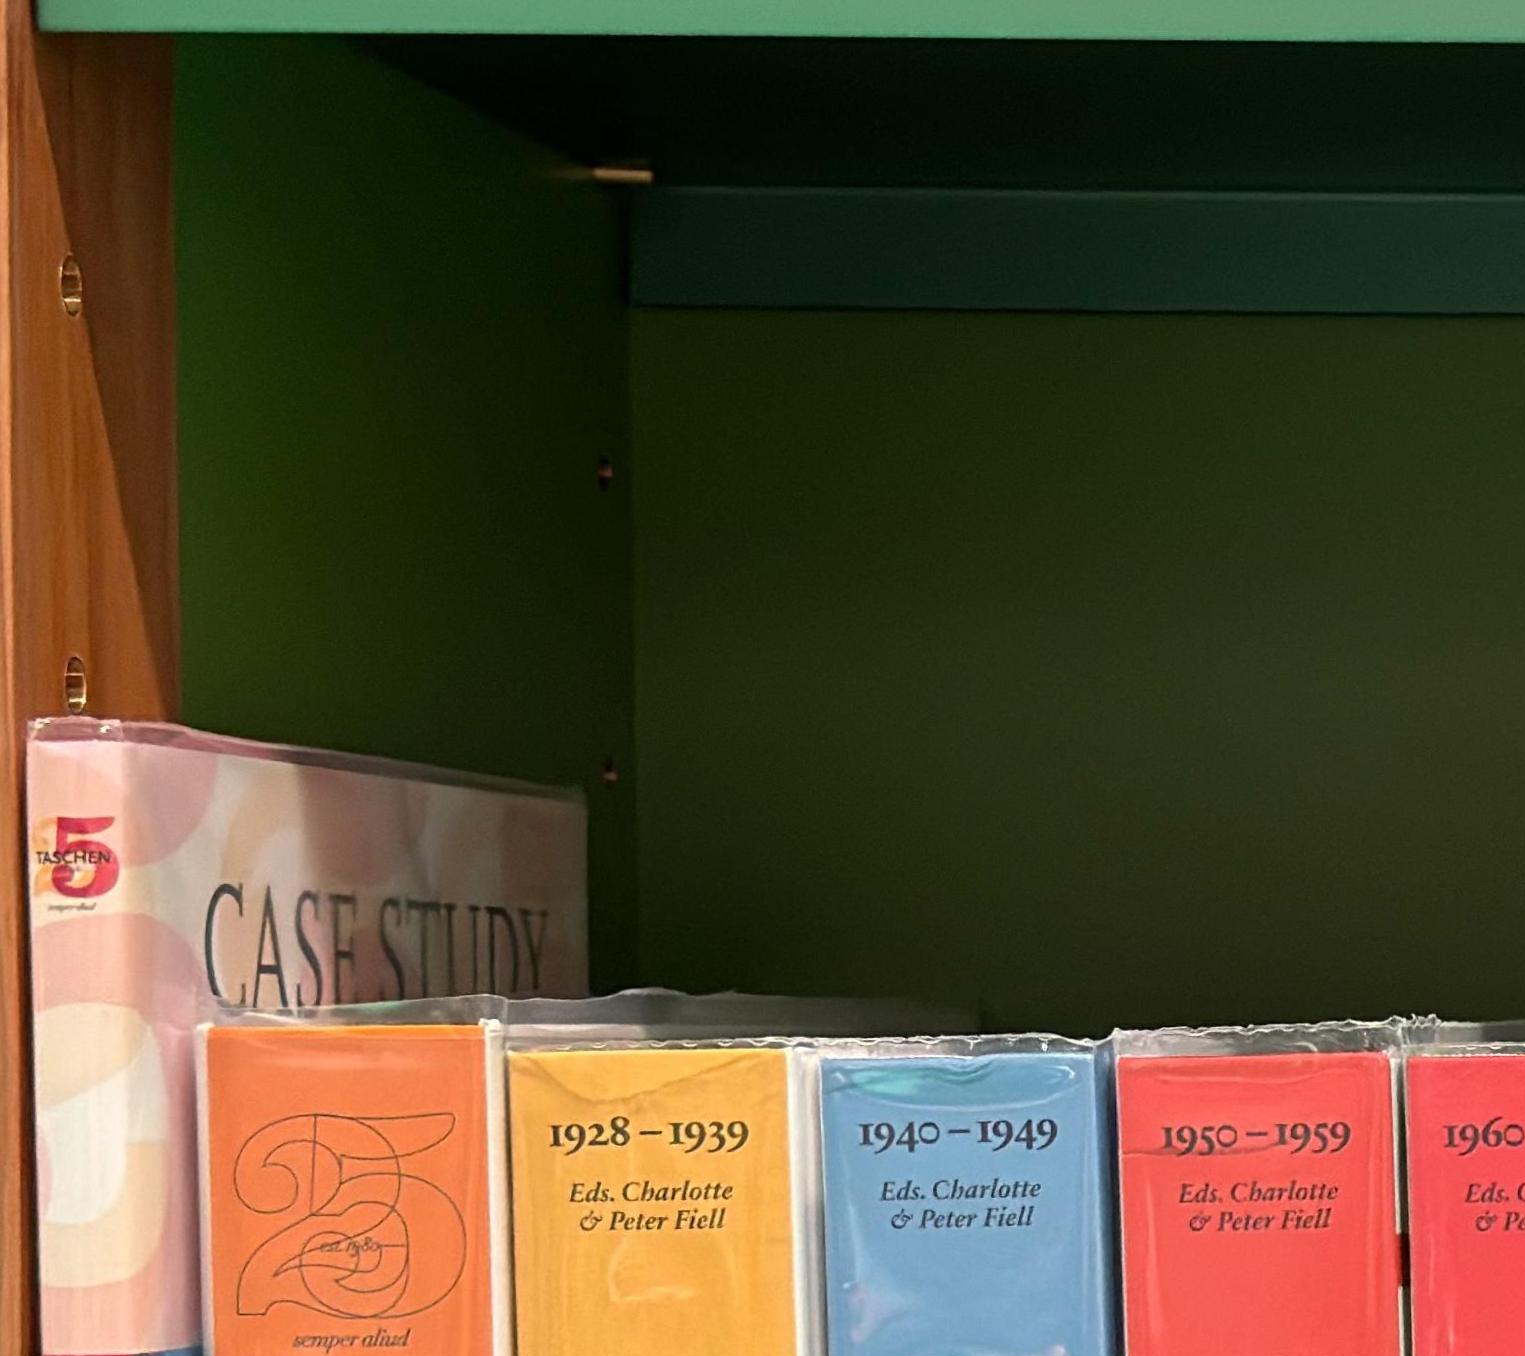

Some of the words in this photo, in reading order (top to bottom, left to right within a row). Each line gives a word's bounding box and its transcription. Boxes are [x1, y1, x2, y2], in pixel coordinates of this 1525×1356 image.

[35, 849, 112, 865] TASCHEN
[204, 883, 358, 1015] CASE
[379, 898, 550, 1001] STUDY
[569, 1181, 616, 1203] Eds.
[621, 1179, 734, 1203] Charlotte
[880, 1180, 926, 1202] Eds.
[932, 1178, 1042, 1201] Charlotte
[1178, 1183, 1223, 1205] Eds.
[1230, 1180, 1339, 1204] Charlotte
[1465, 1182, 1508, 1204] Eds.
[609, 1210, 669, 1232] Peter
[674, 1207, 726, 1231] Fiell
[919, 1208, 978, 1231] Peter
[983, 1205, 1034, 1229] Fiell
[1217, 1211, 1276, 1233] Peter
[1281, 1207, 1332, 1231] Fiell
[291, 1332, 357, 1354] semper
[361, 1327, 412, 1348] aliud
